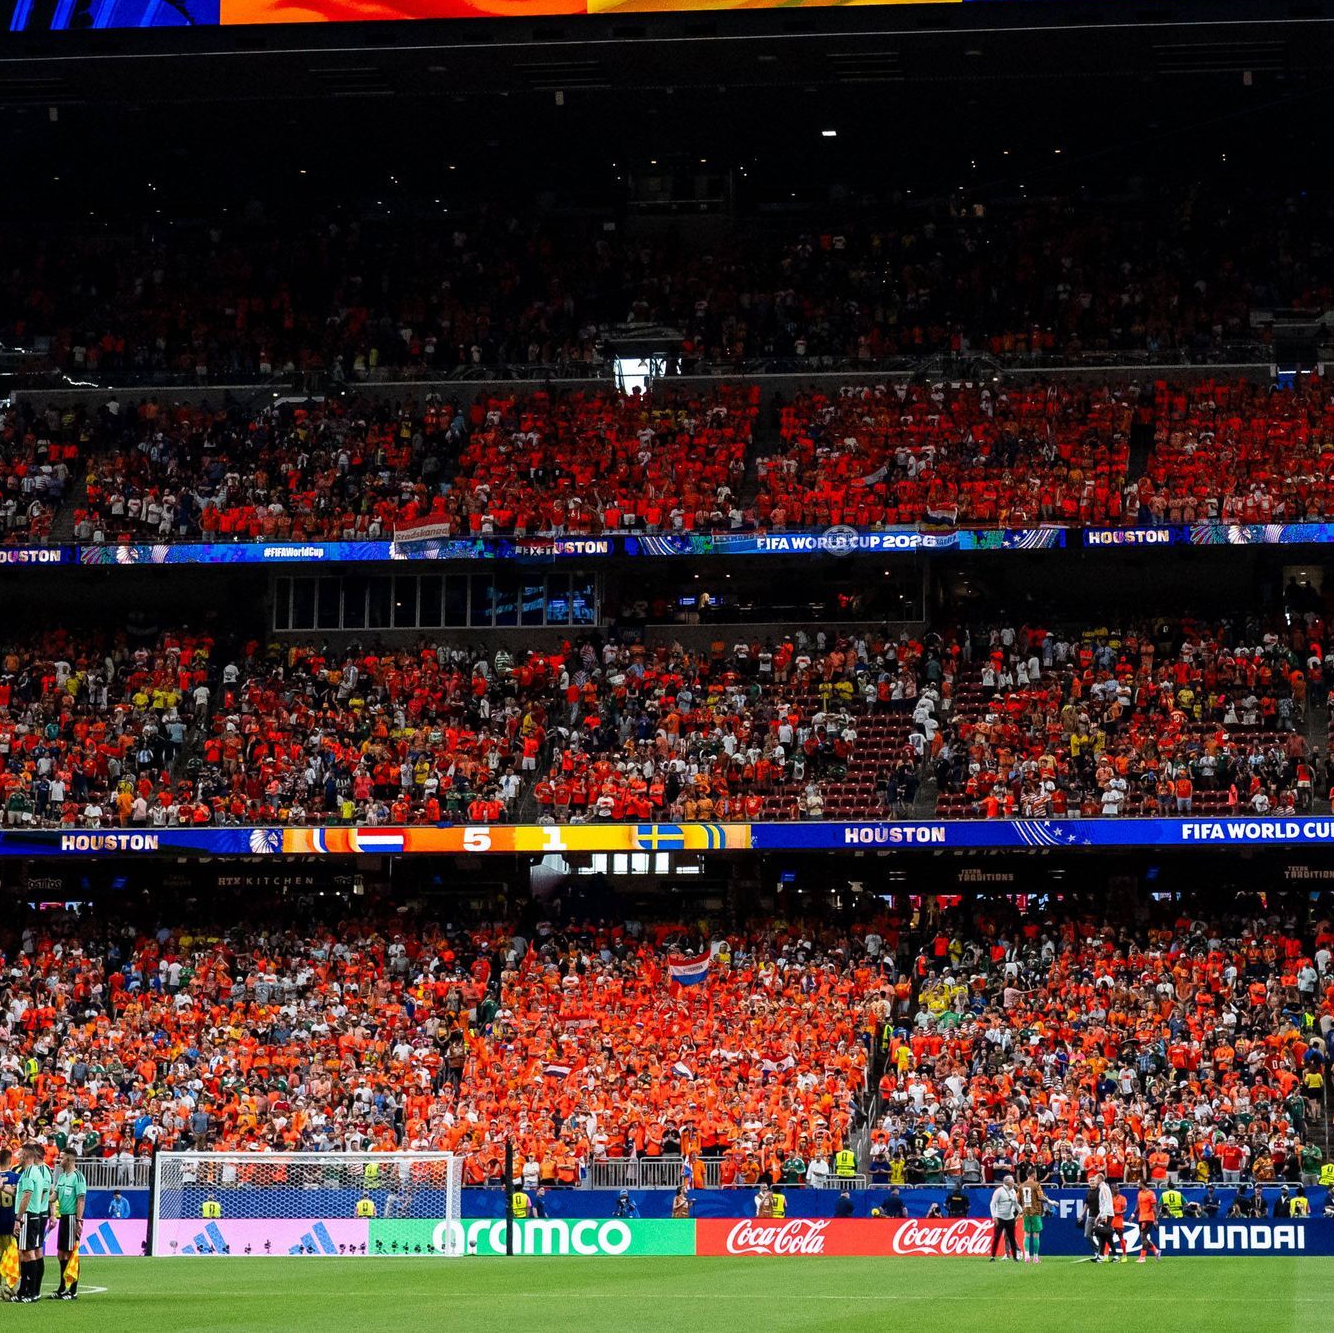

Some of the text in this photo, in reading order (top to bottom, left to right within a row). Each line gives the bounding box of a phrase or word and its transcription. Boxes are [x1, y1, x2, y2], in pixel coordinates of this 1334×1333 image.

[757, 538, 789, 549] FIFA
[851, 535, 881, 548] CUP
[882, 534, 937, 548] 2026
[1089, 530, 1169, 543] HOUSTON
[264, 547, 323, 558] #FIFAWorldCup
[553, 541, 607, 554] USTON
[464, 827, 566, 851] 5 1
[845, 827, 945, 843] HOUSTON
[1183, 824, 1224, 839] FIFA
[1227, 823, 1299, 838] WORLD
[62, 835, 158, 850] HOUSTON
[246, 876, 314, 887] KITCHEN
[431, 1218, 633, 1256] aramco
[726, 1219, 831, 1254] Coca-Cola
[892, 1219, 995, 1254] Coca-Cola
[1156, 1226, 1304, 1252] HYUNDAI
